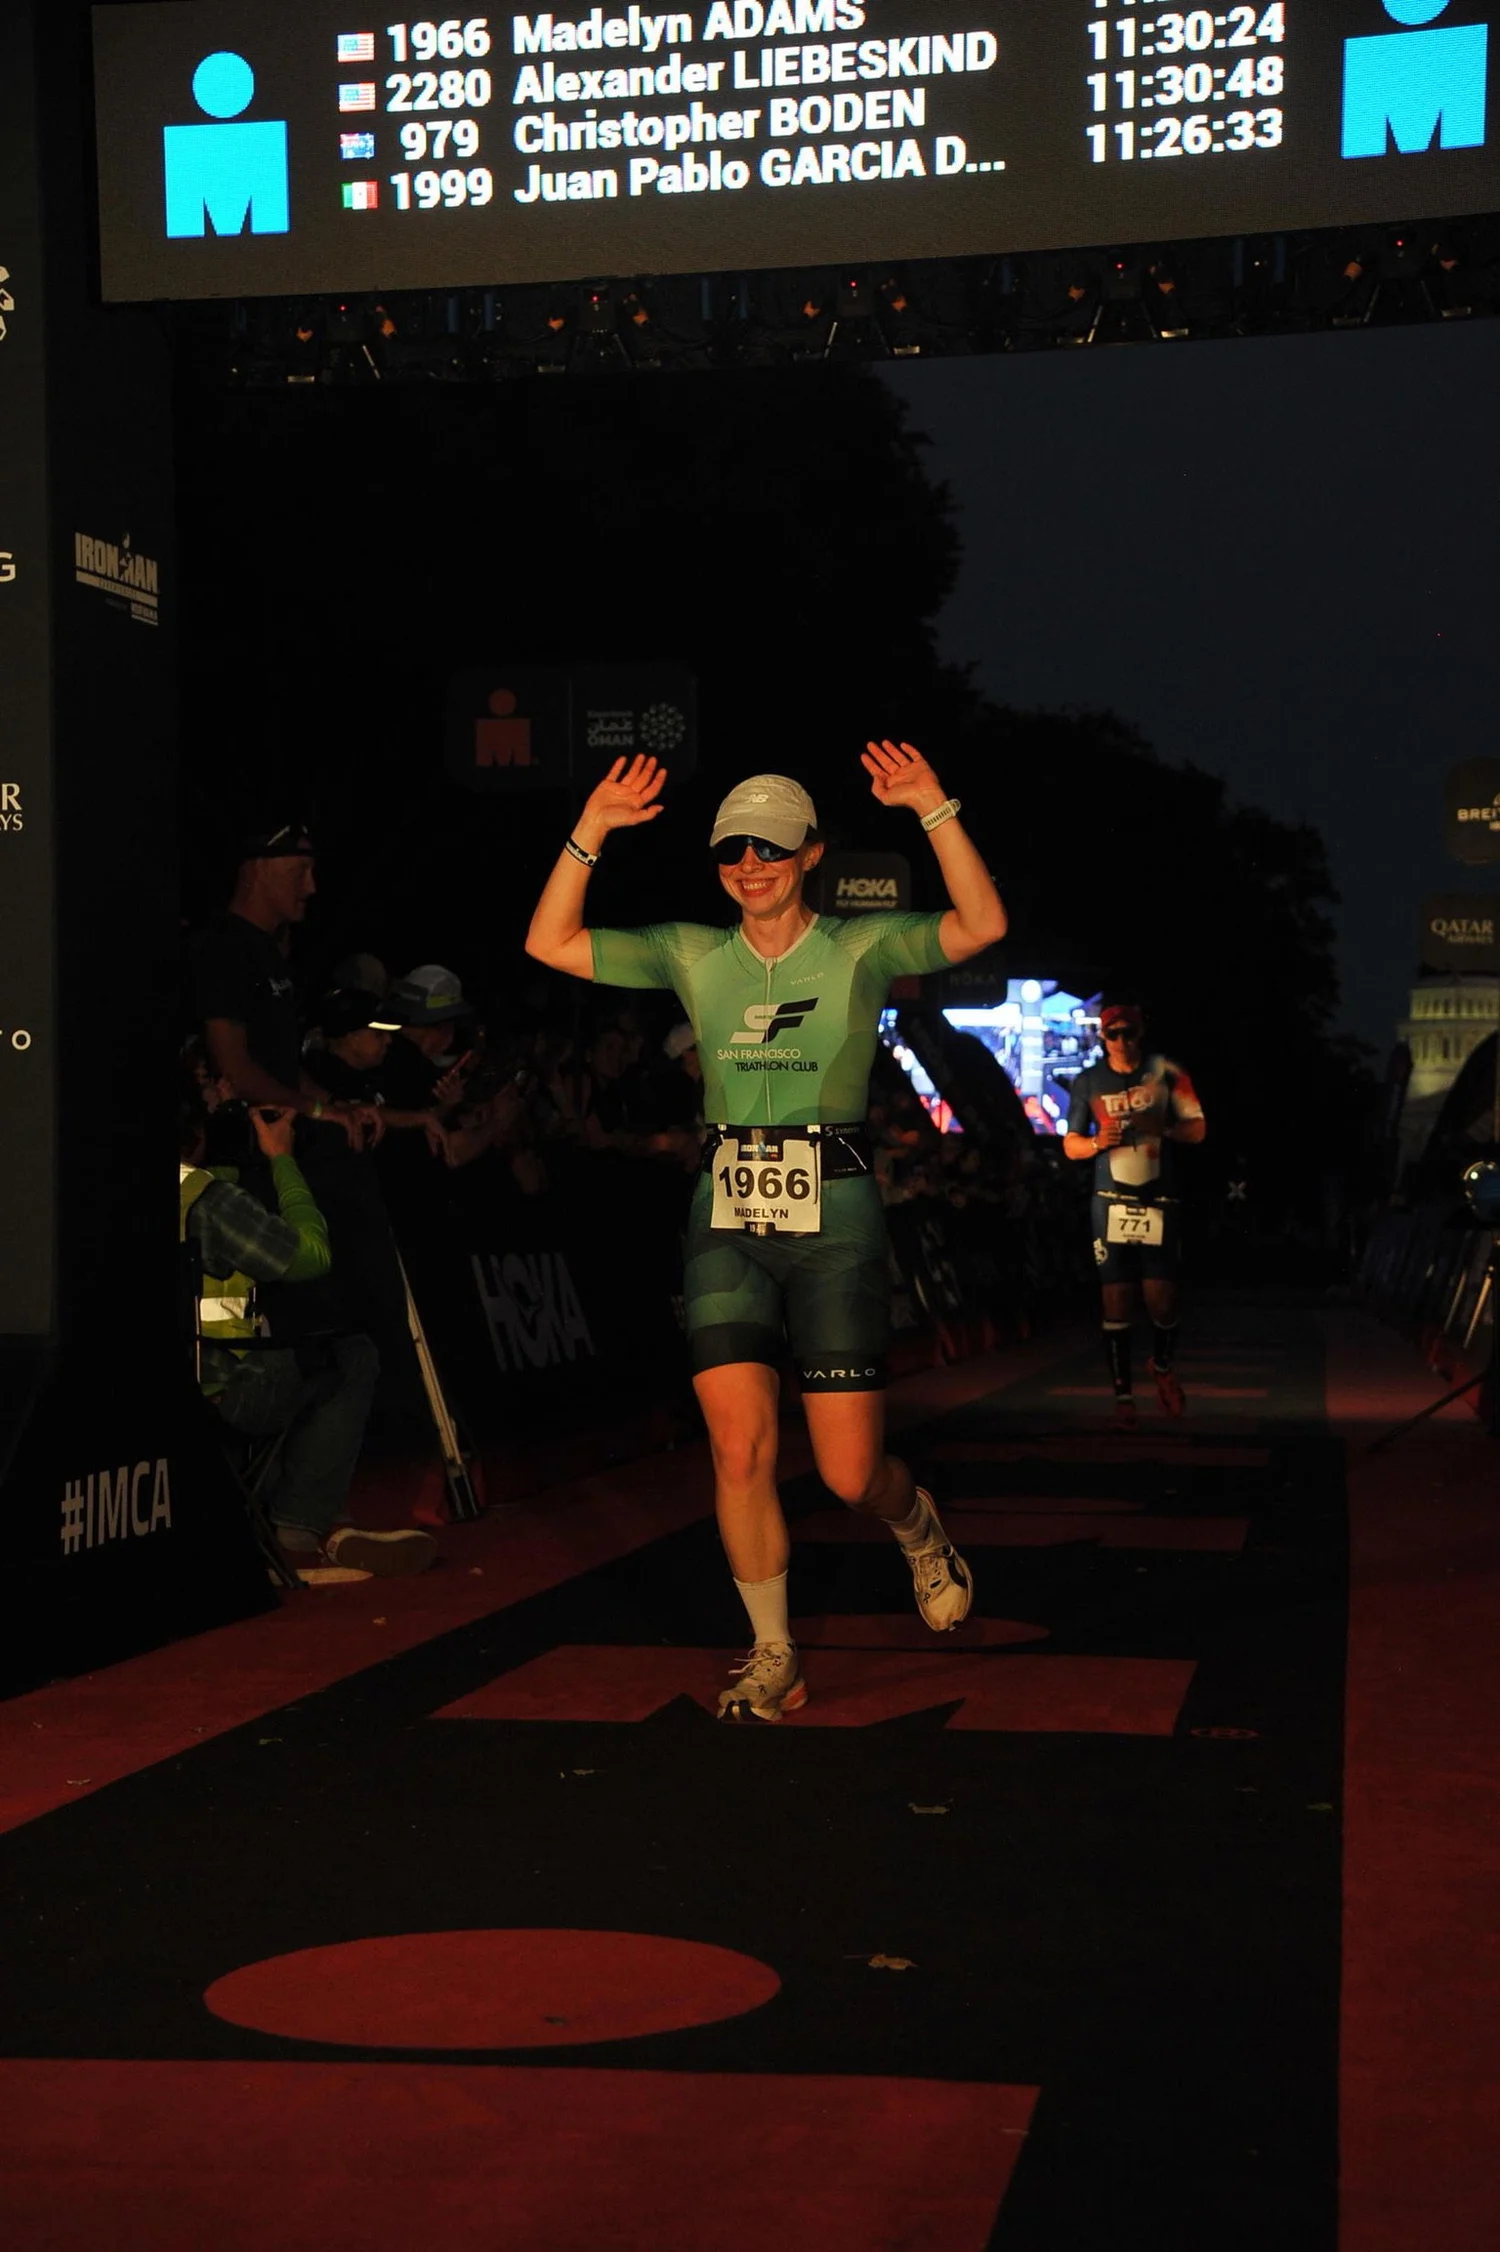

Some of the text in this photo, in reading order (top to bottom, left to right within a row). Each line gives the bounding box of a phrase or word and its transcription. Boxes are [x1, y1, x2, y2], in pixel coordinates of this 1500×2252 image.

[387, 0, 866, 62] 1966 Madelyn ADAMS
[385, 2, 1285, 112] 2280 Alexander LIEBESKIND 11:30:24
[400, 55, 1284, 161] 979 Christopher BODEN 11:30:48
[390, 167, 493, 210] 1999
[513, 164, 618, 204] Juan
[628, 150, 750, 197] Pablo
[759, 139, 927, 188] GARCIA
[1085, 107, 1283, 163] 11:26:33
[74, 531, 159, 595] IRONMAN
[836, 877, 899, 898] HOKA
[1430, 917, 1494, 938] QATAR
[717, 1047, 801, 1060] SAN FRANCISCO
[735, 1060, 819, 1073] TRIATHLON CLUB
[718, 1166, 811, 1201] 1966
[734, 1206, 789, 1219] MADELYN
[1118, 1218, 1151, 1233] 771
[469, 1251, 597, 1373] HOKA
[802, 1367, 877, 1380] VARLO
[60, 1457, 173, 1557] #IMCA
